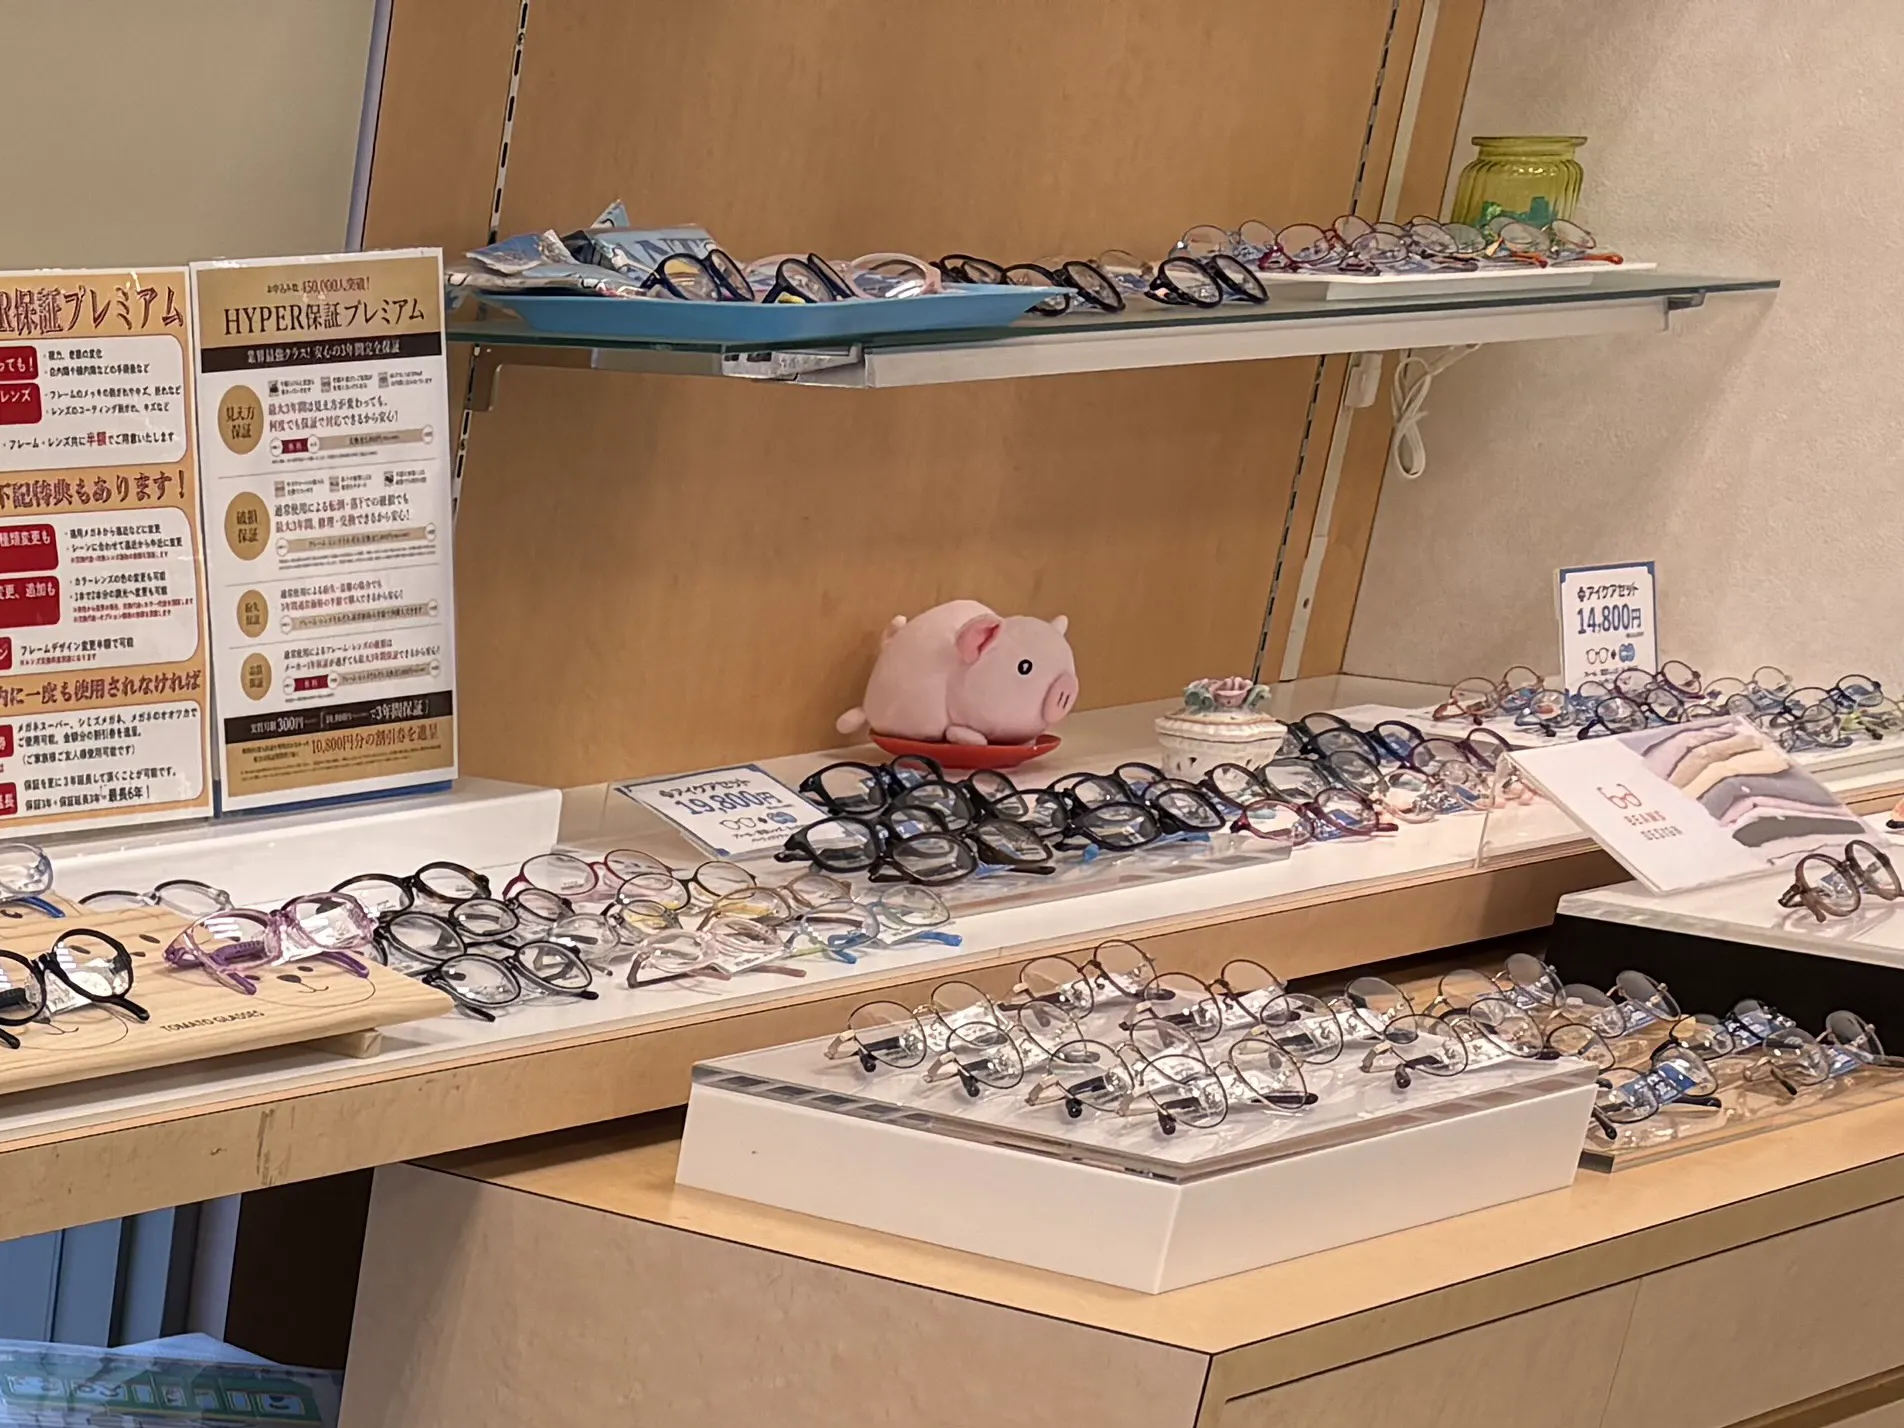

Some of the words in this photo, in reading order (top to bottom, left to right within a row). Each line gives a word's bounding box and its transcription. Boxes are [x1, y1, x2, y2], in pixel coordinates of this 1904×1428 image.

[223, 298, 425, 336] HYPER保証プレミアム
[225, 403, 255, 423] 見え方
[230, 422, 253, 440] 保証
[1586, 581, 1640, 601] アイケアセット
[1576, 603, 1643, 635] 14,800円
[674, 789, 784, 816] 19,800円
[159, 1018, 214, 1033] TOMATO
